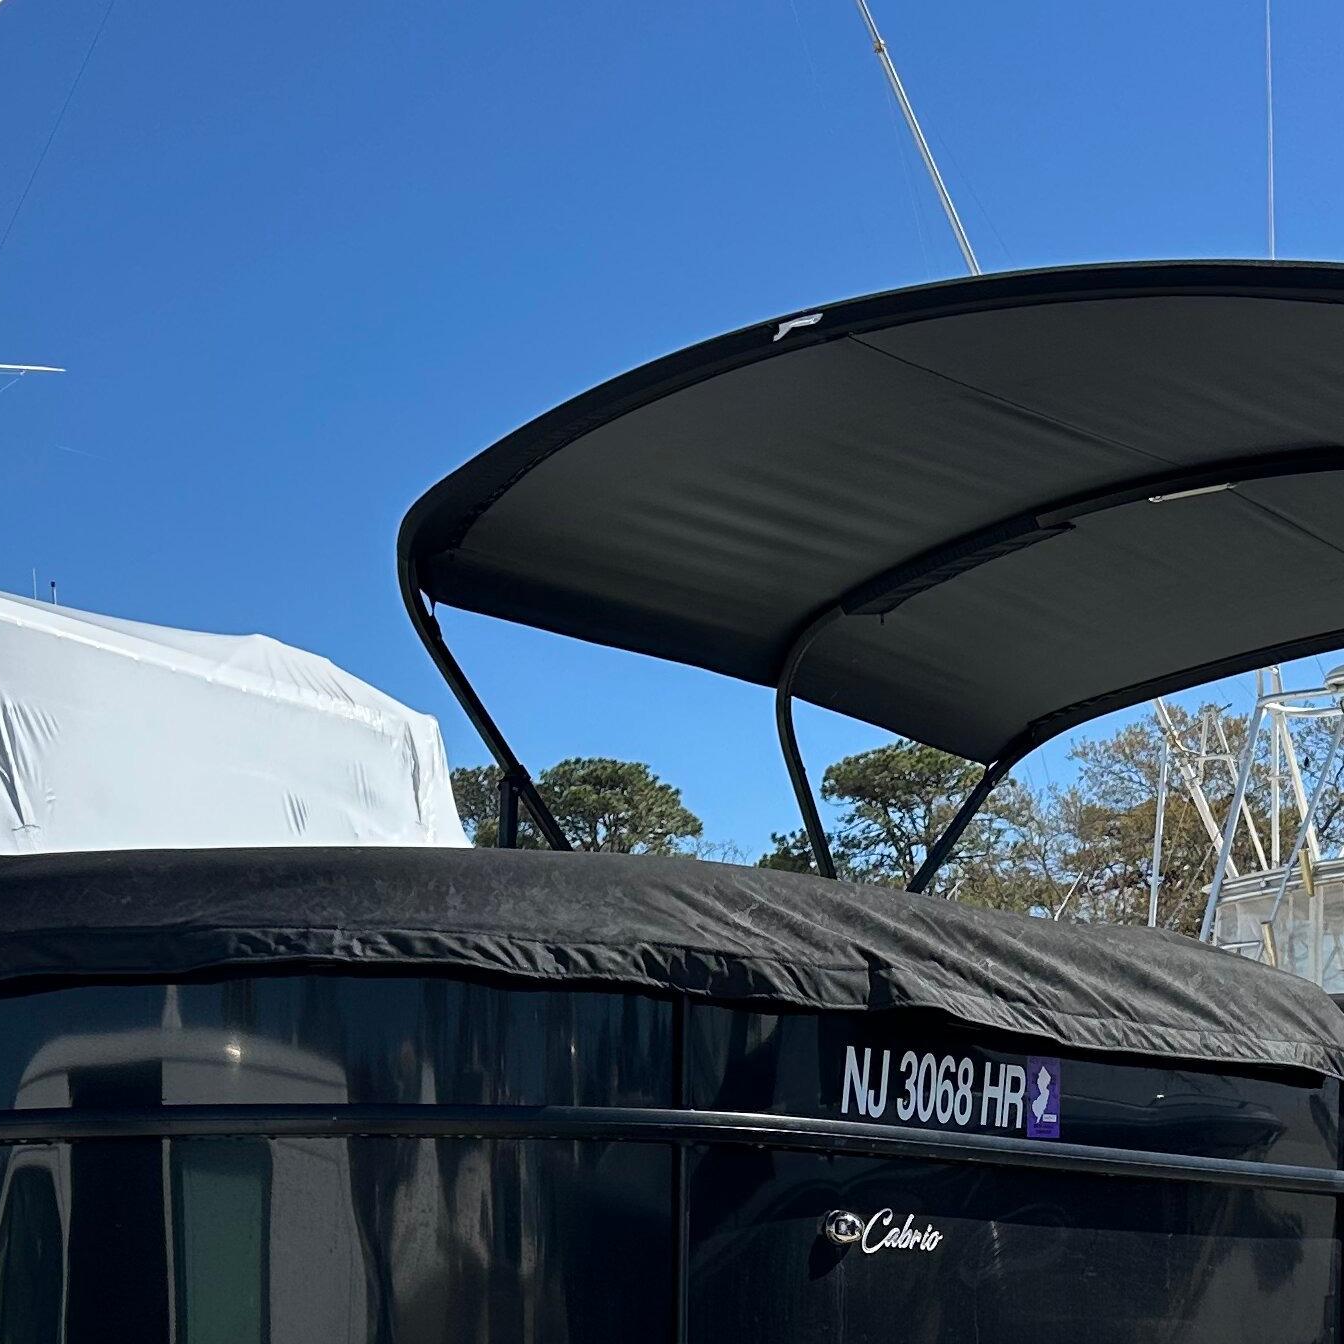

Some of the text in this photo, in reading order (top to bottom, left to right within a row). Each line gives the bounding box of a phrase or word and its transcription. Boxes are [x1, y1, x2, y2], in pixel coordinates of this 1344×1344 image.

[841, 1046, 1027, 1129] NJ 3068 HR
[861, 1208, 944, 1254] Cabrio
